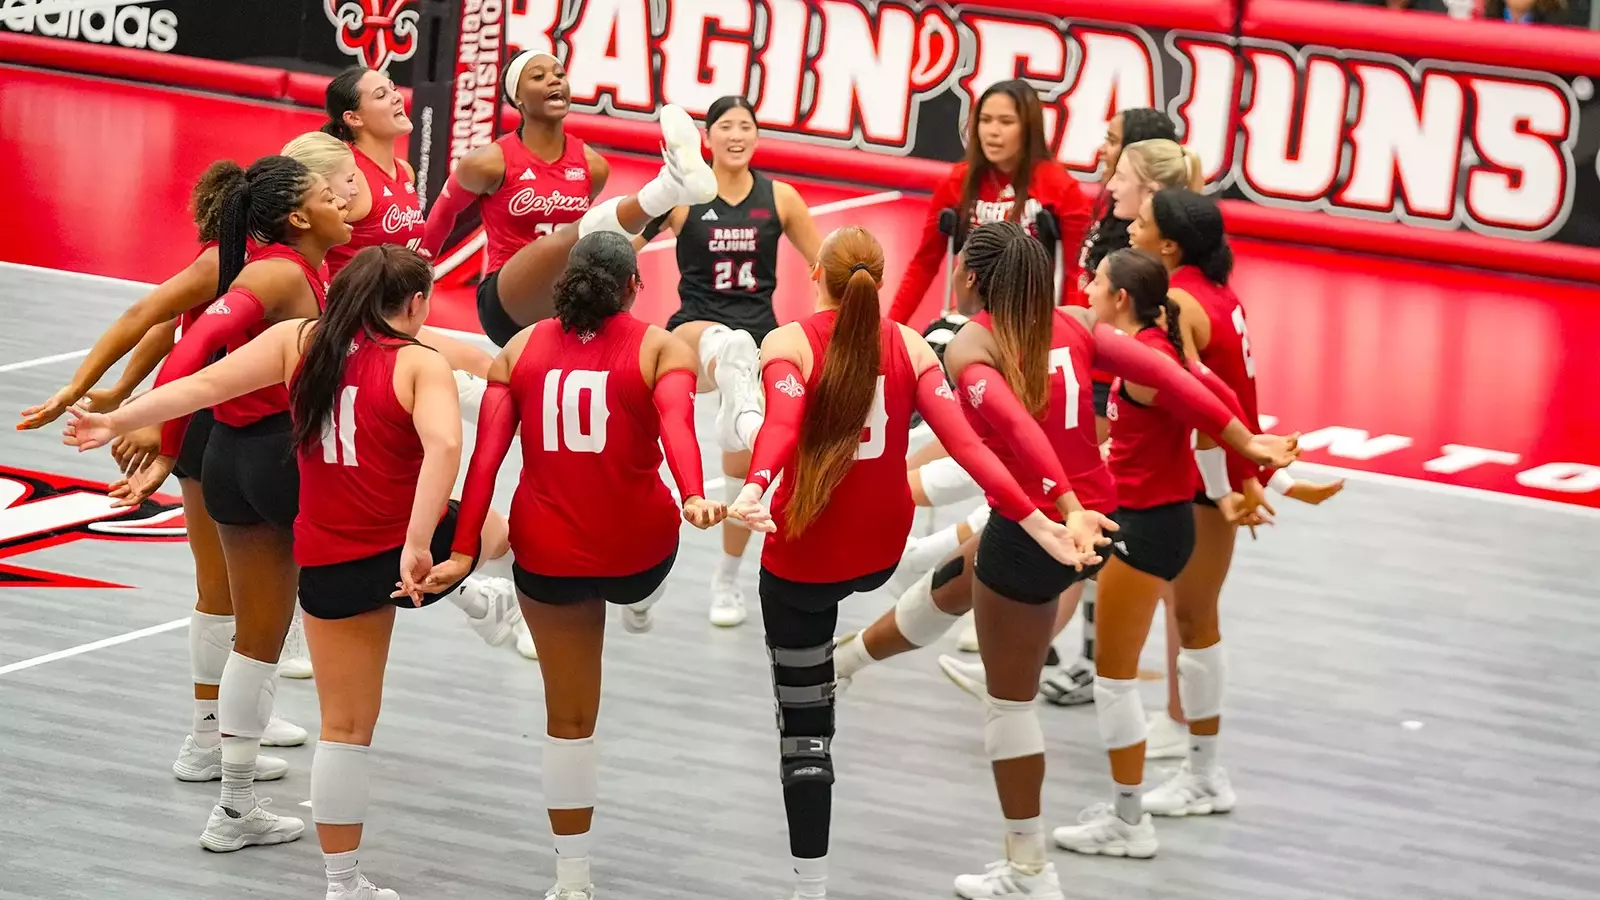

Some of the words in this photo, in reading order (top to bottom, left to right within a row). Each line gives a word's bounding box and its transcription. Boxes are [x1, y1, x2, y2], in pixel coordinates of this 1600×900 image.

[966, 17, 1568, 229] CAJUNS
[708, 240, 757, 252] CAJUNS
[714, 261, 757, 290] 24
[320, 385, 360, 467] 11
[543, 368, 610, 454] 10
